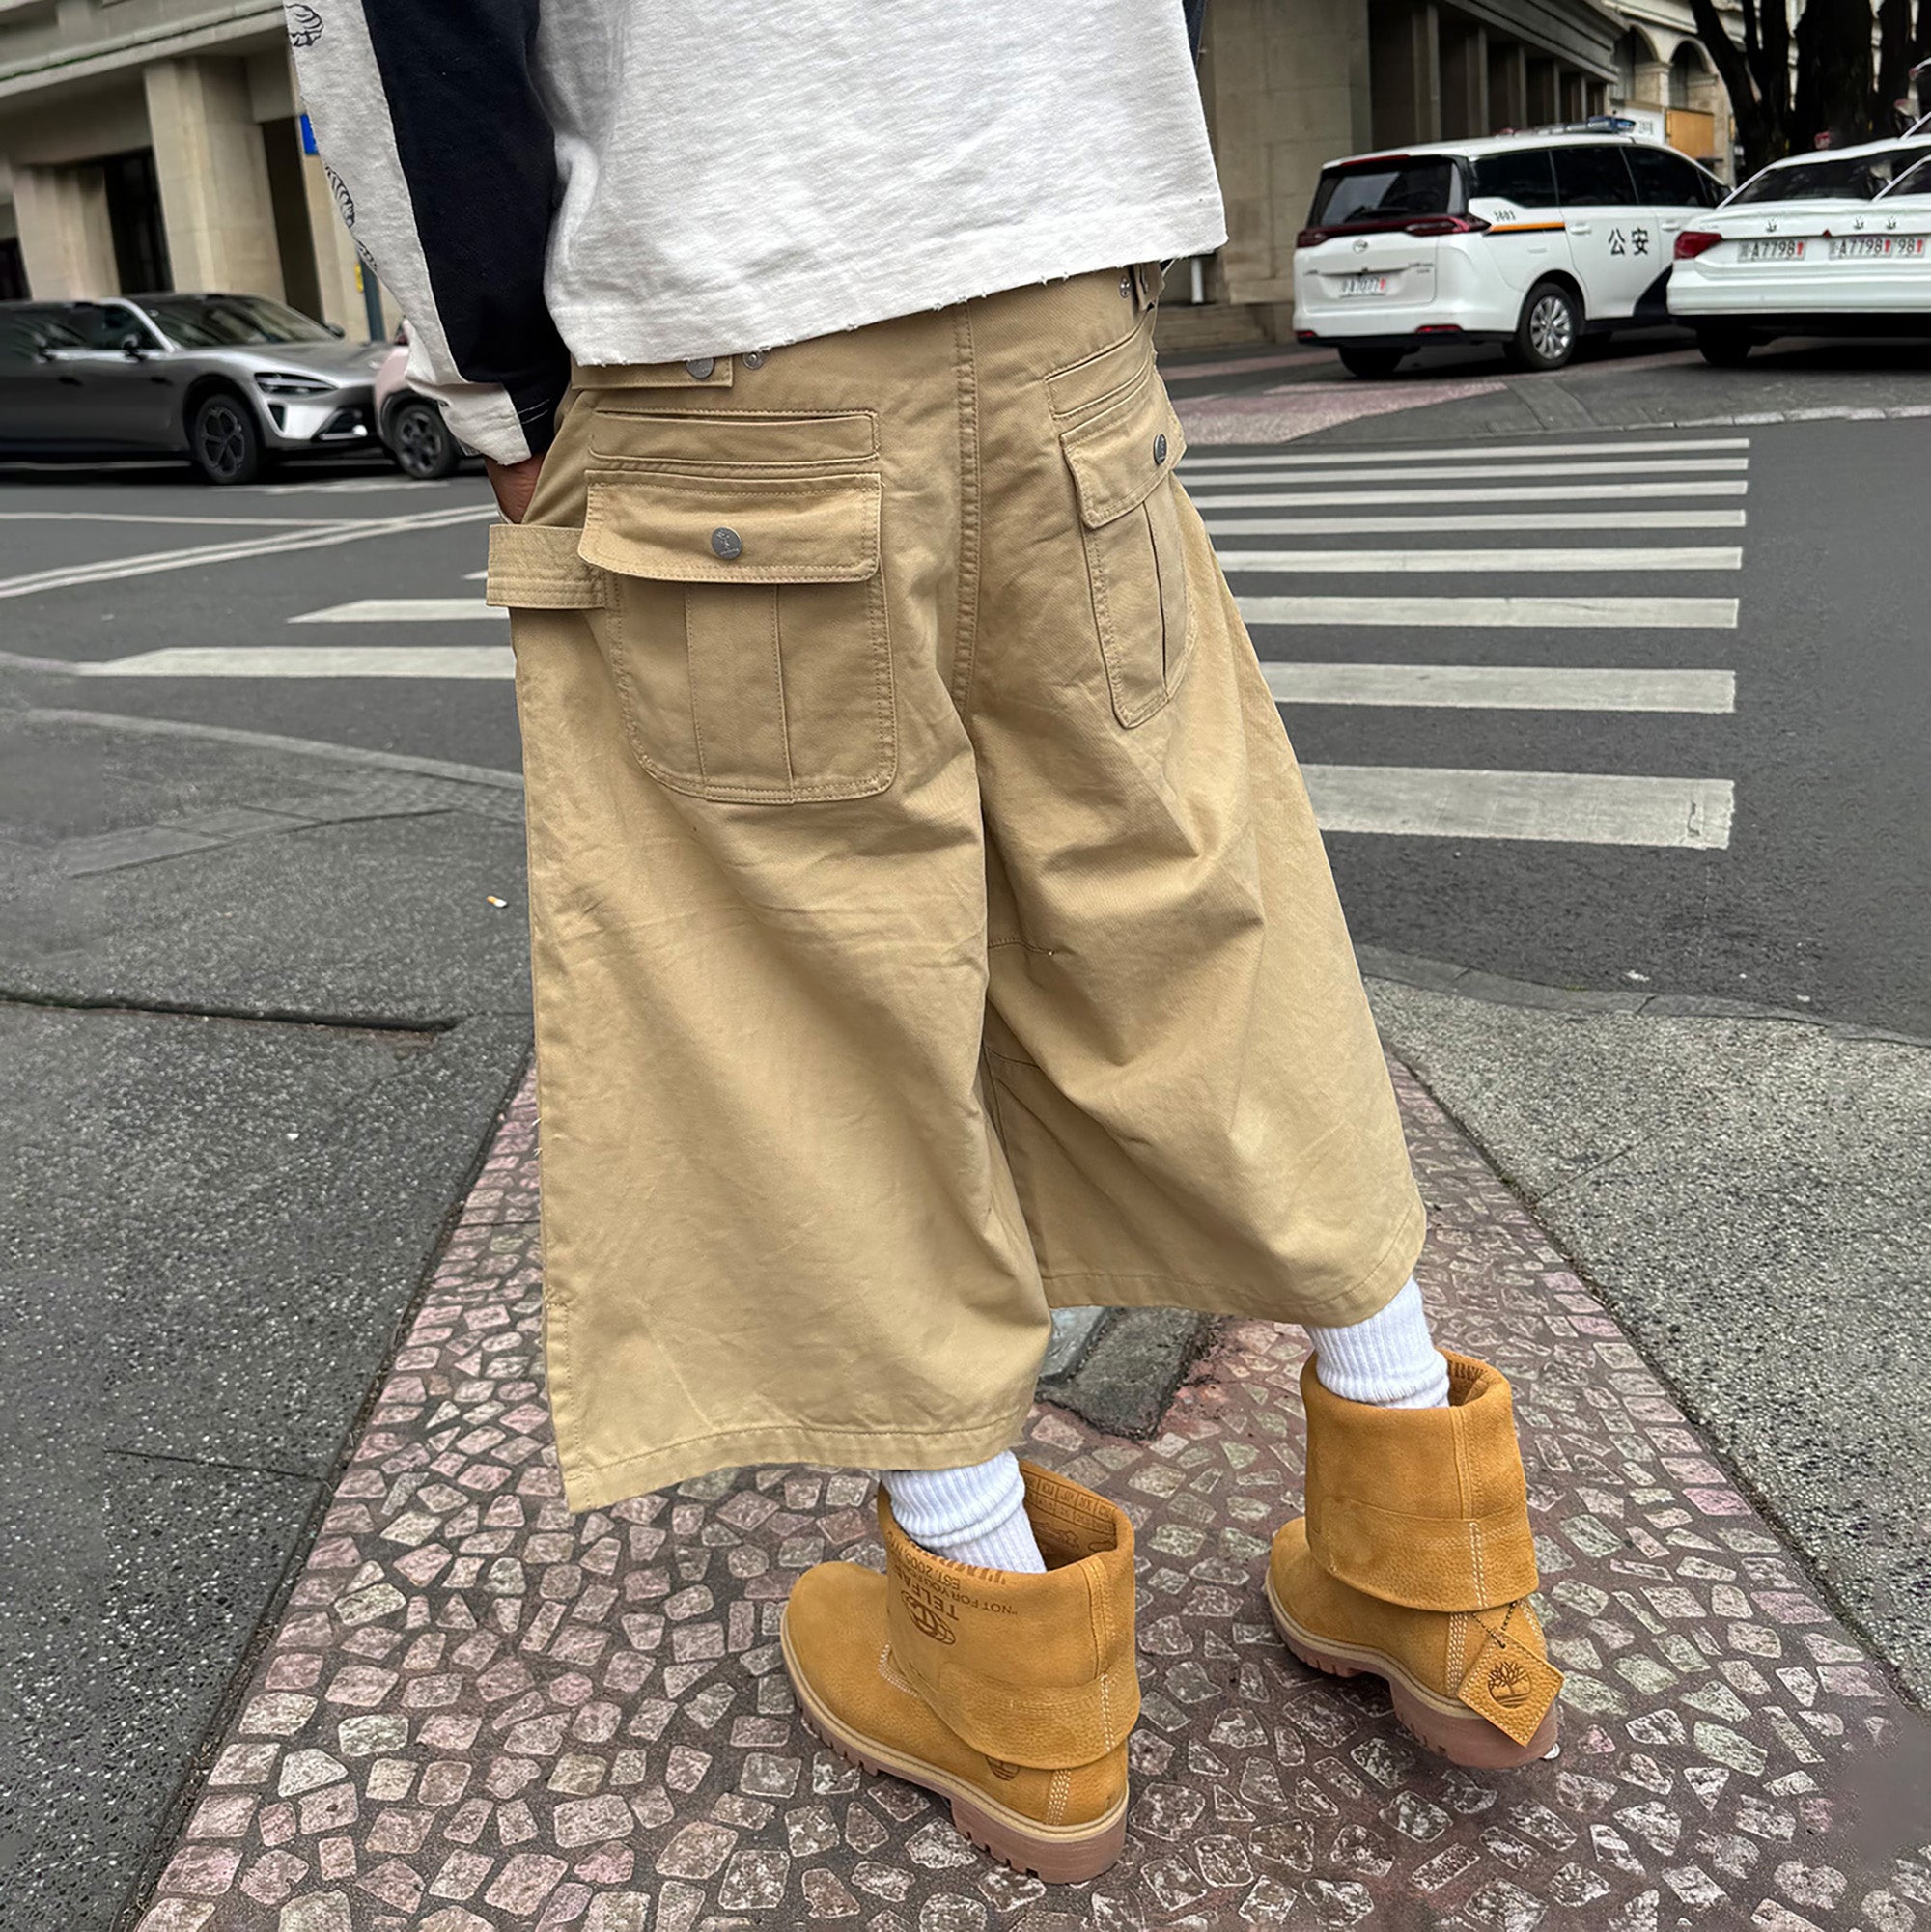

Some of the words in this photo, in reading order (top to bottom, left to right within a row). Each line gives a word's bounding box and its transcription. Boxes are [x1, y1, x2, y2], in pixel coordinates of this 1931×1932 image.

[1608, 227, 1649, 256] 公安
[934, 1568, 962, 1591] EST.
[951, 1591, 979, 1609] FOR
